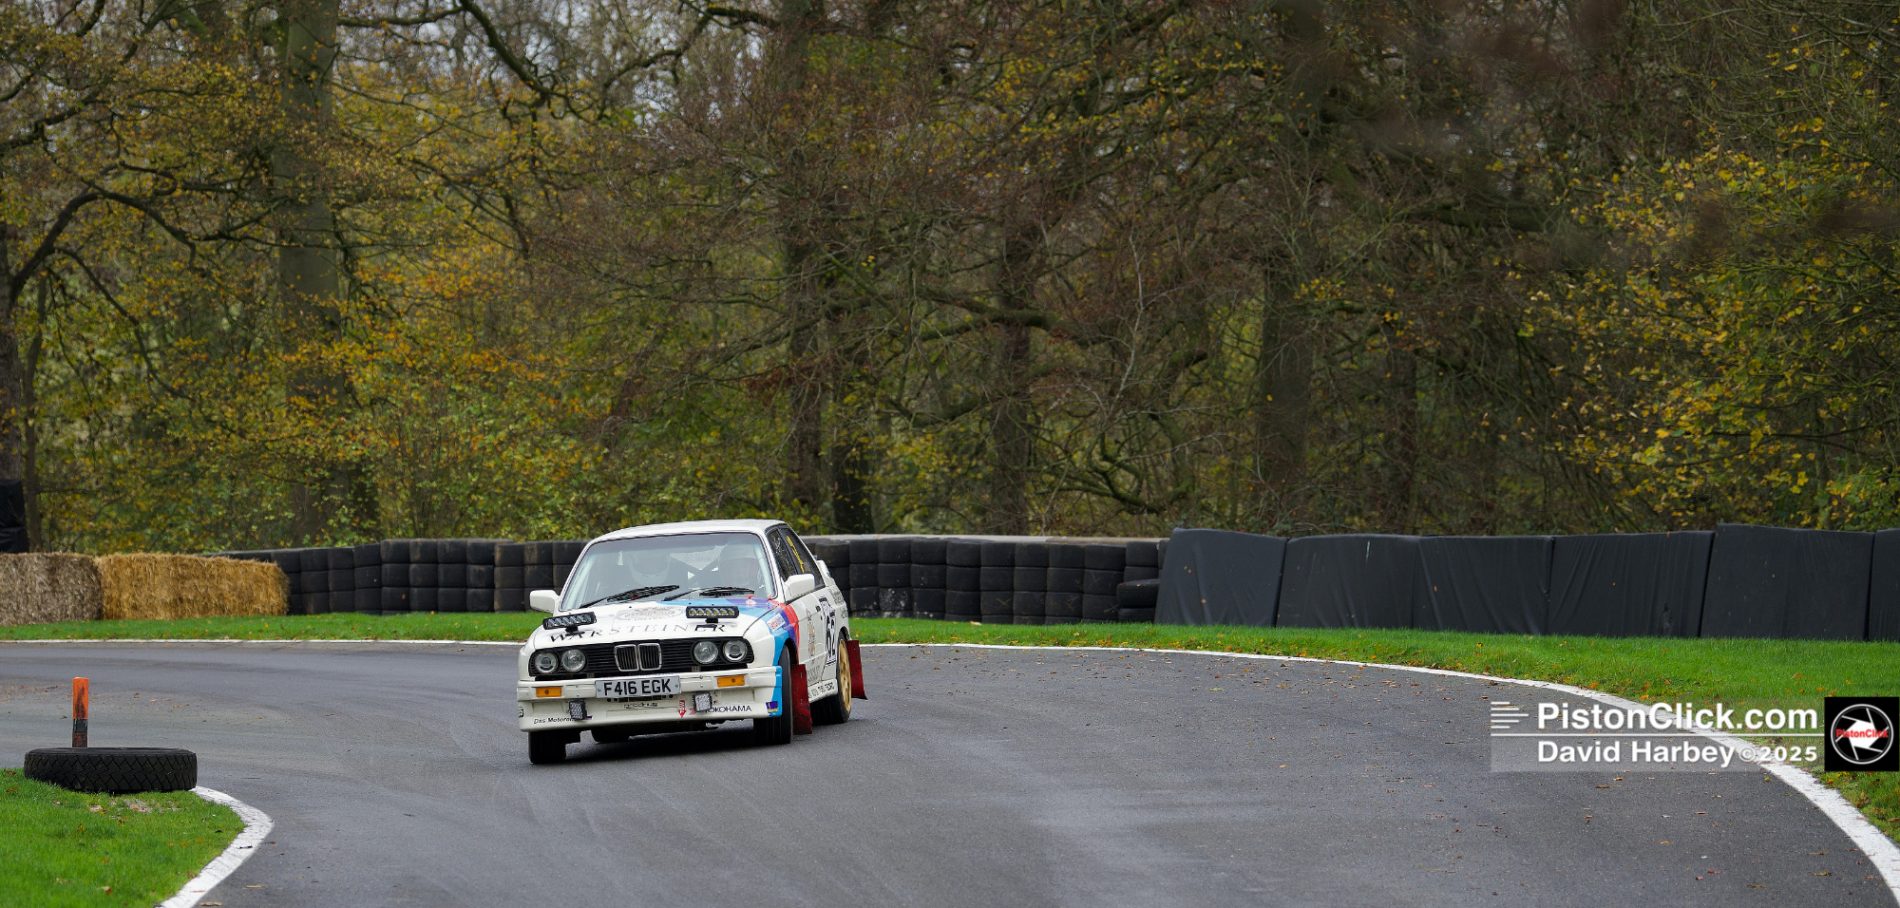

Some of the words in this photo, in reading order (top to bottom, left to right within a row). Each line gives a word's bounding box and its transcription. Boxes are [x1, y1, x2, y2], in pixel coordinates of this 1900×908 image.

[603, 681, 637, 696] F416
[641, 679, 672, 694] EGK
[704, 704, 753, 713] OKOHAMA
